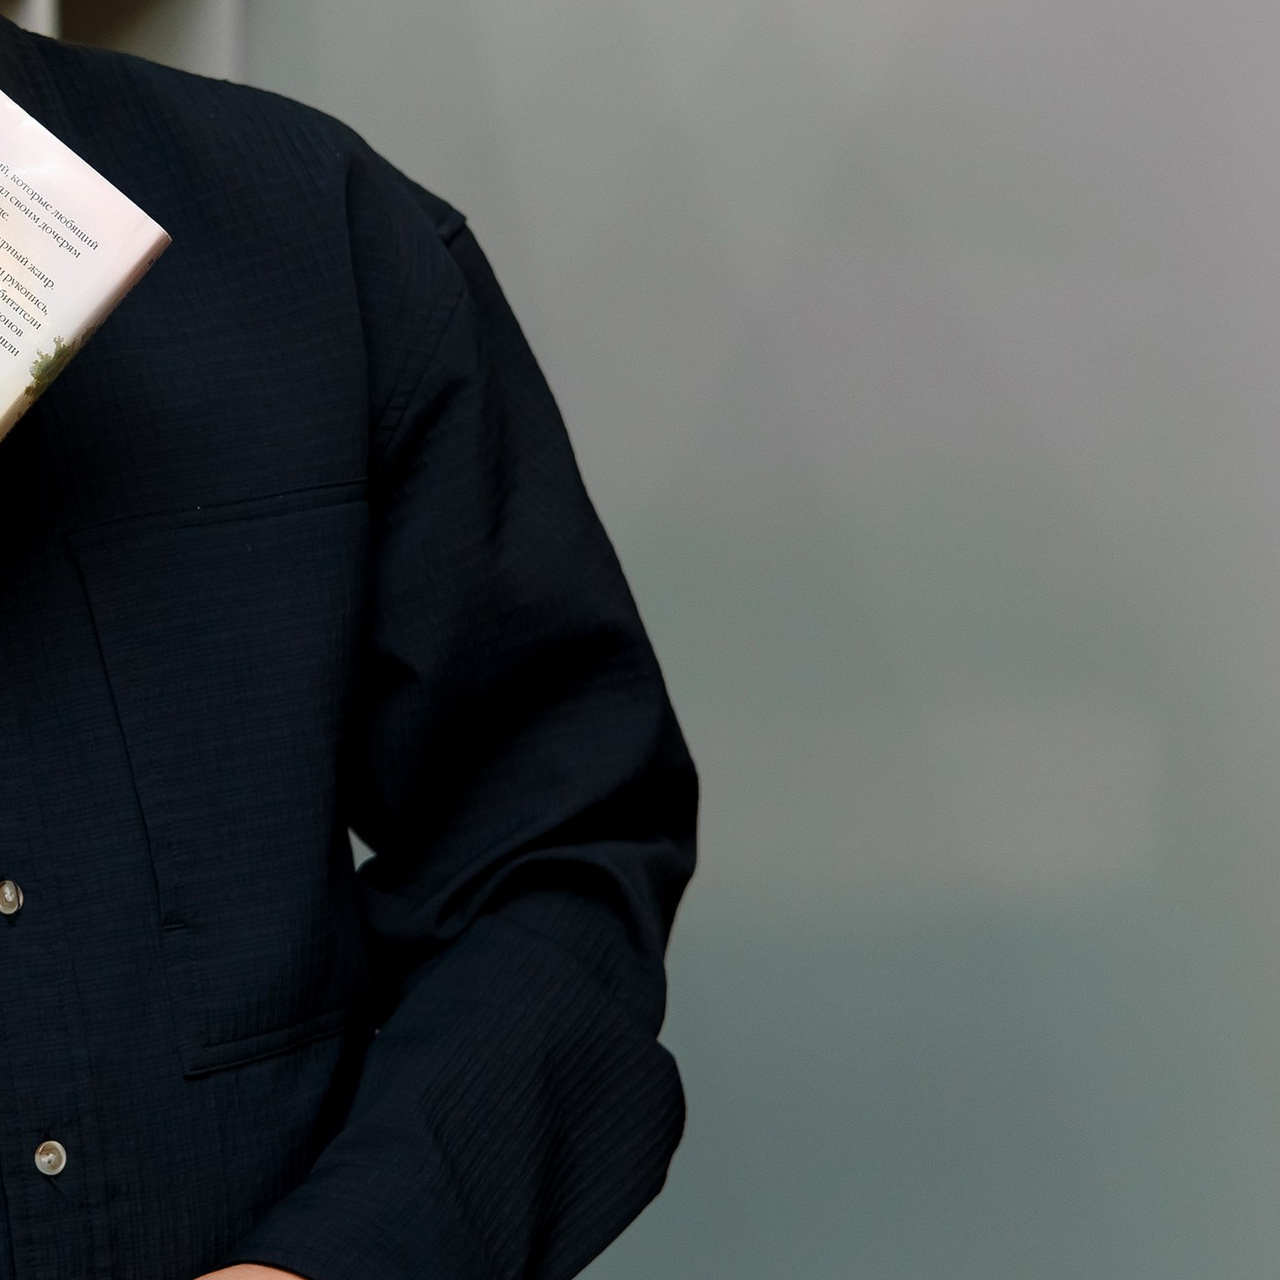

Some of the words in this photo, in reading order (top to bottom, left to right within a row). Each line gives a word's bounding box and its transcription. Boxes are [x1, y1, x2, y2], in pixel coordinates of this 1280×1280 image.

[9, 195, 40, 223] своим
[37, 221, 81, 258] дочерям
[10, 174, 52, 211] которые
[50, 209, 98, 250] любящий
[1, 273, 47, 316] рукопись,
[27, 263, 54, 290] жанр.
